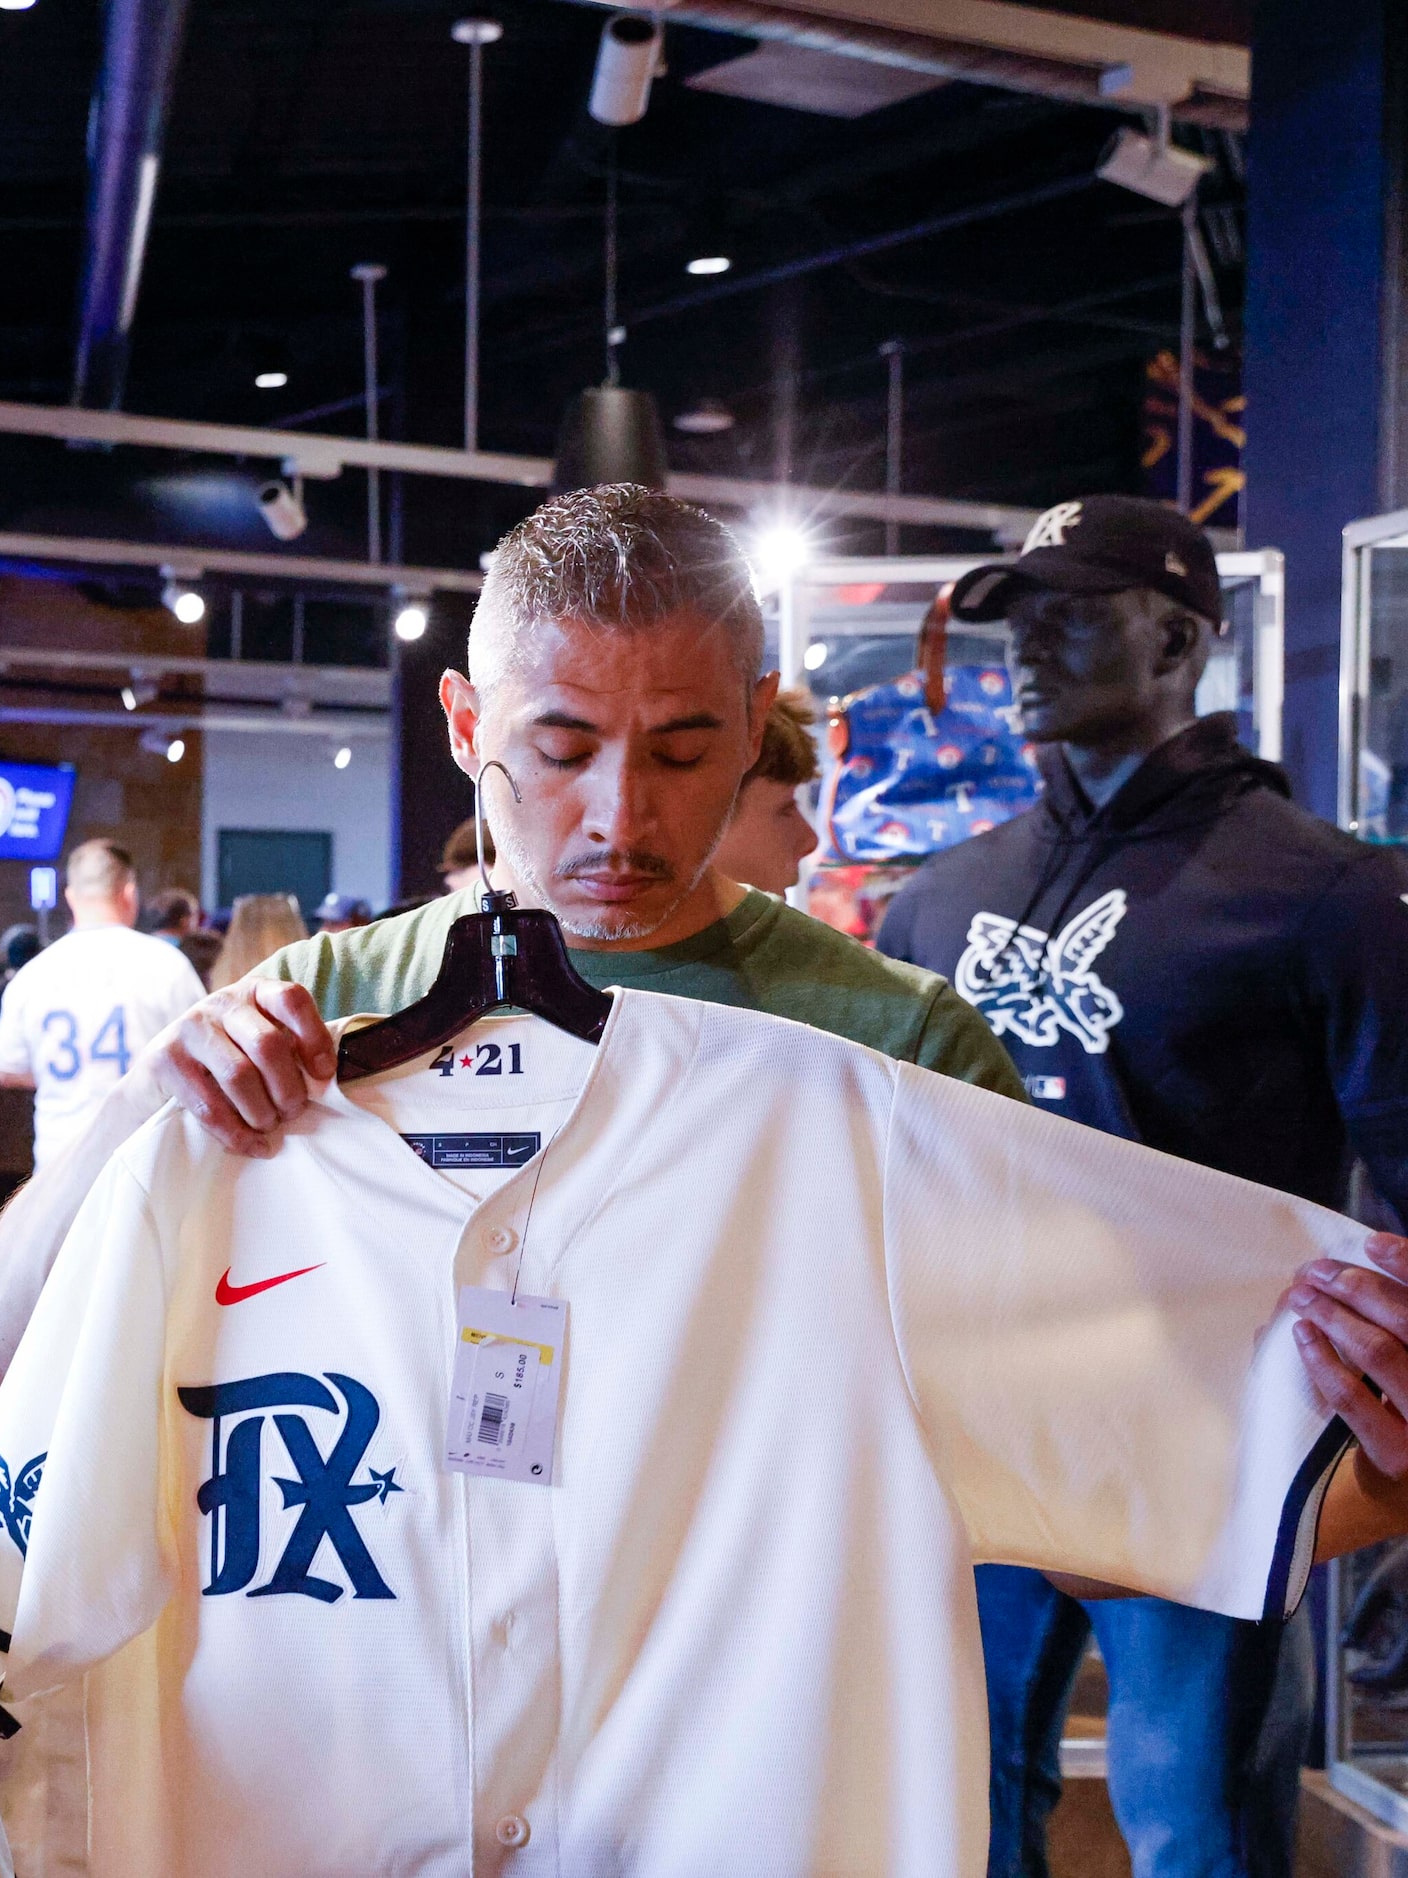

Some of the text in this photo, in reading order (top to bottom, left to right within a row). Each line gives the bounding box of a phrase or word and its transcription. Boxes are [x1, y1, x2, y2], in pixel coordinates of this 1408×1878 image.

[42, 1004, 131, 1081] 34
[495, 1371, 505, 1380] S
[513, 1354, 527, 1388] $185.00
